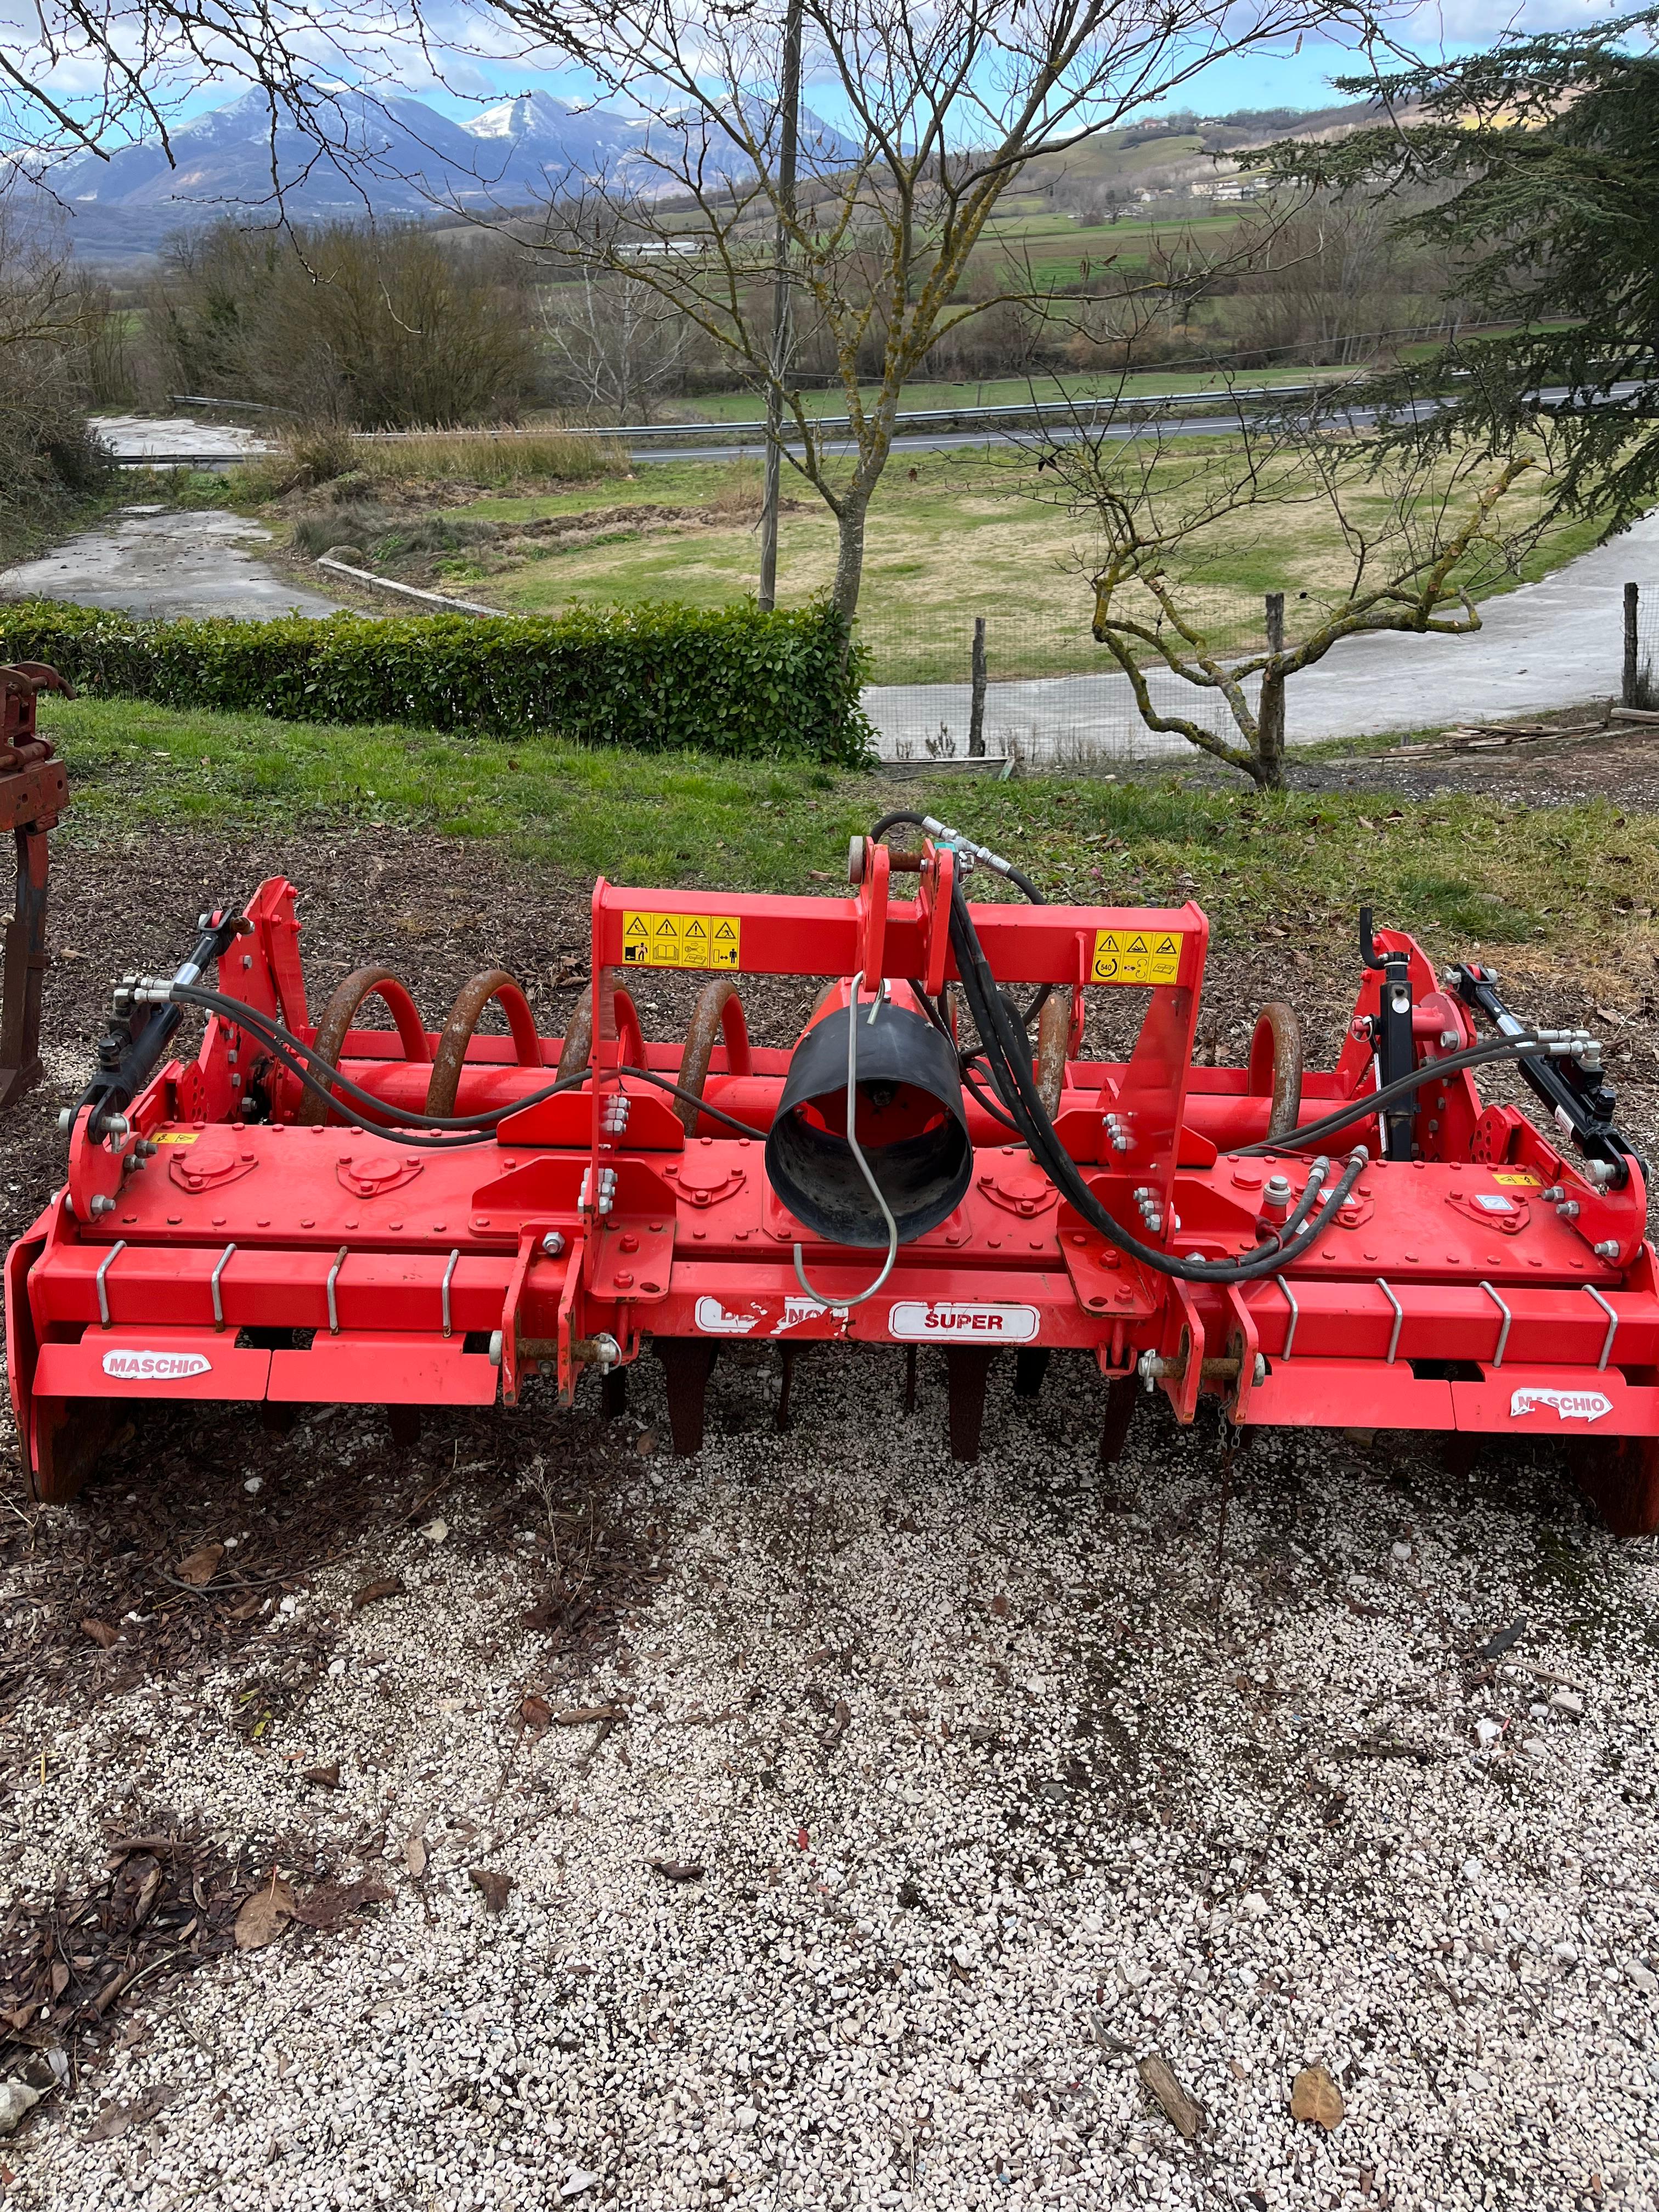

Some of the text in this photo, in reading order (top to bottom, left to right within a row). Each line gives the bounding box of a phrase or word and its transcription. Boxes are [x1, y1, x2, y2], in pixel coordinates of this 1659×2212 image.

[924, 1313, 1003, 1330] SUPER
[109, 1358, 204, 1373] MASCHIO
[1517, 1396, 1605, 1412] MSCHIO
